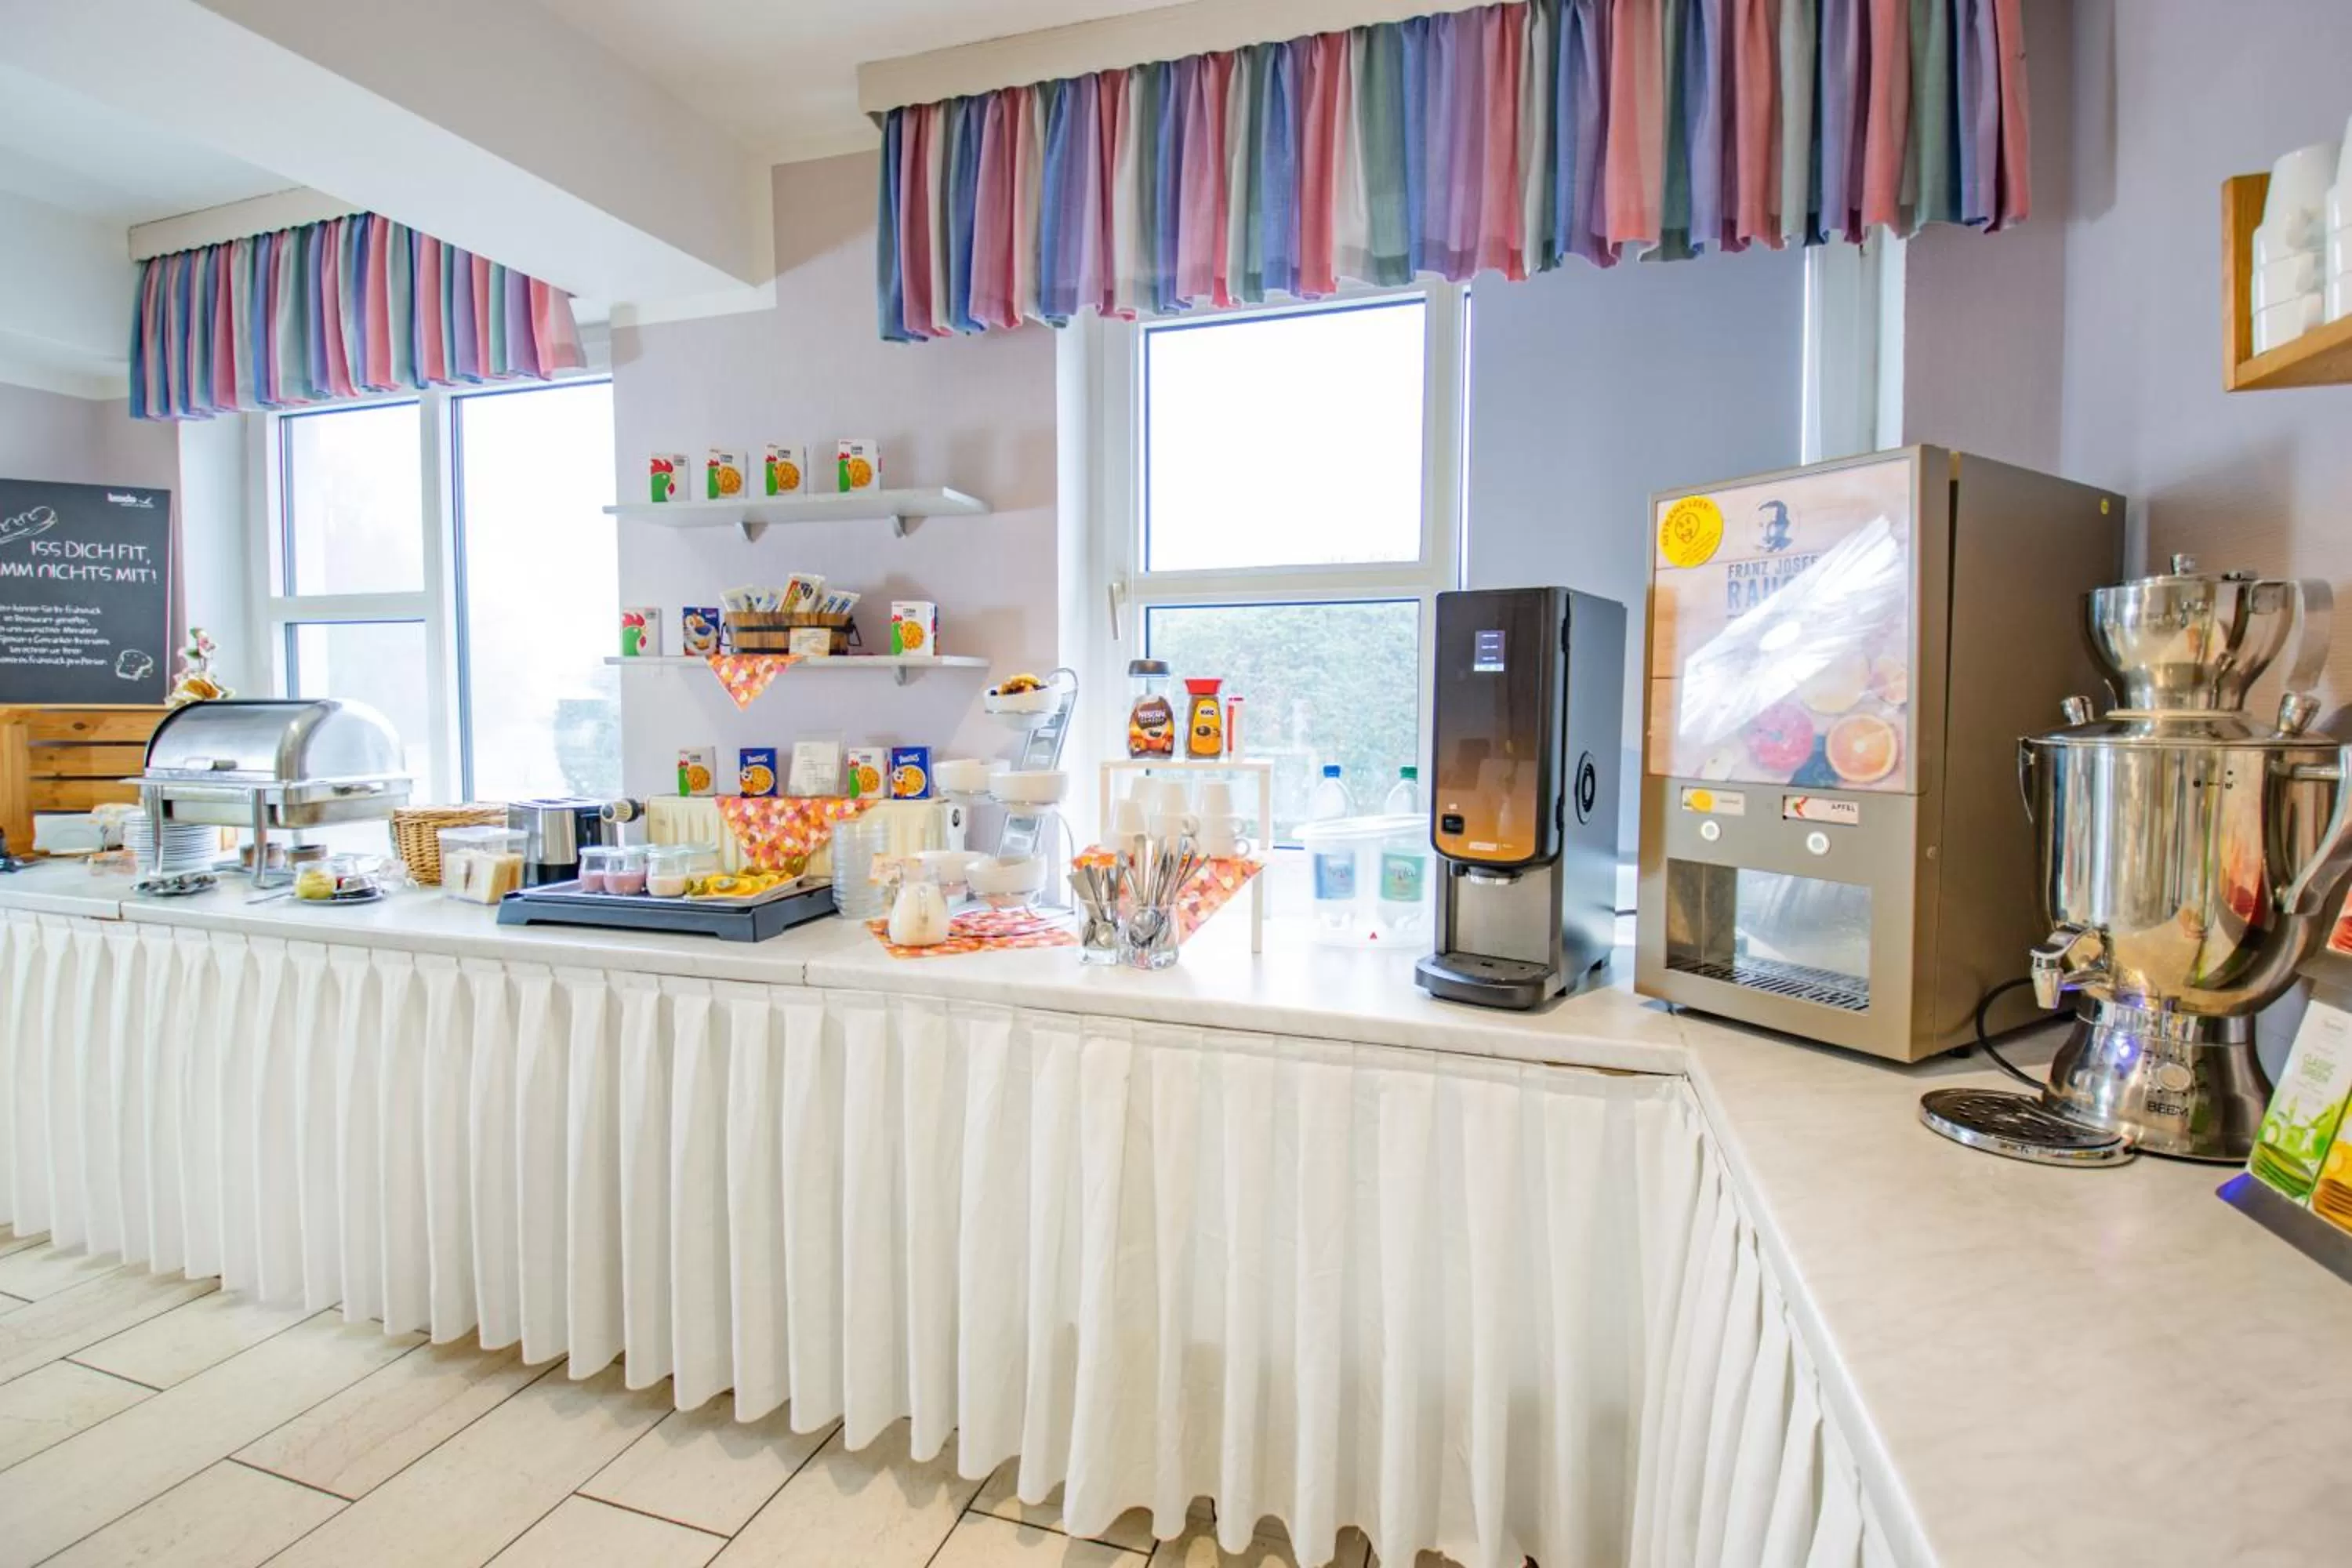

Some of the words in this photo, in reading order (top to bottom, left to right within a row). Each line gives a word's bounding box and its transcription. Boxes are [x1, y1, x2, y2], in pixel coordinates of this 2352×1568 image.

[31, 539, 62, 557] ISS
[65, 540, 115, 560] DICH
[118, 543, 151, 565] FIT,
[116, 566, 158, 584] MIT!
[1727, 561, 1769, 579] FRANZ
[1831, 803, 1857, 813] APFEL
